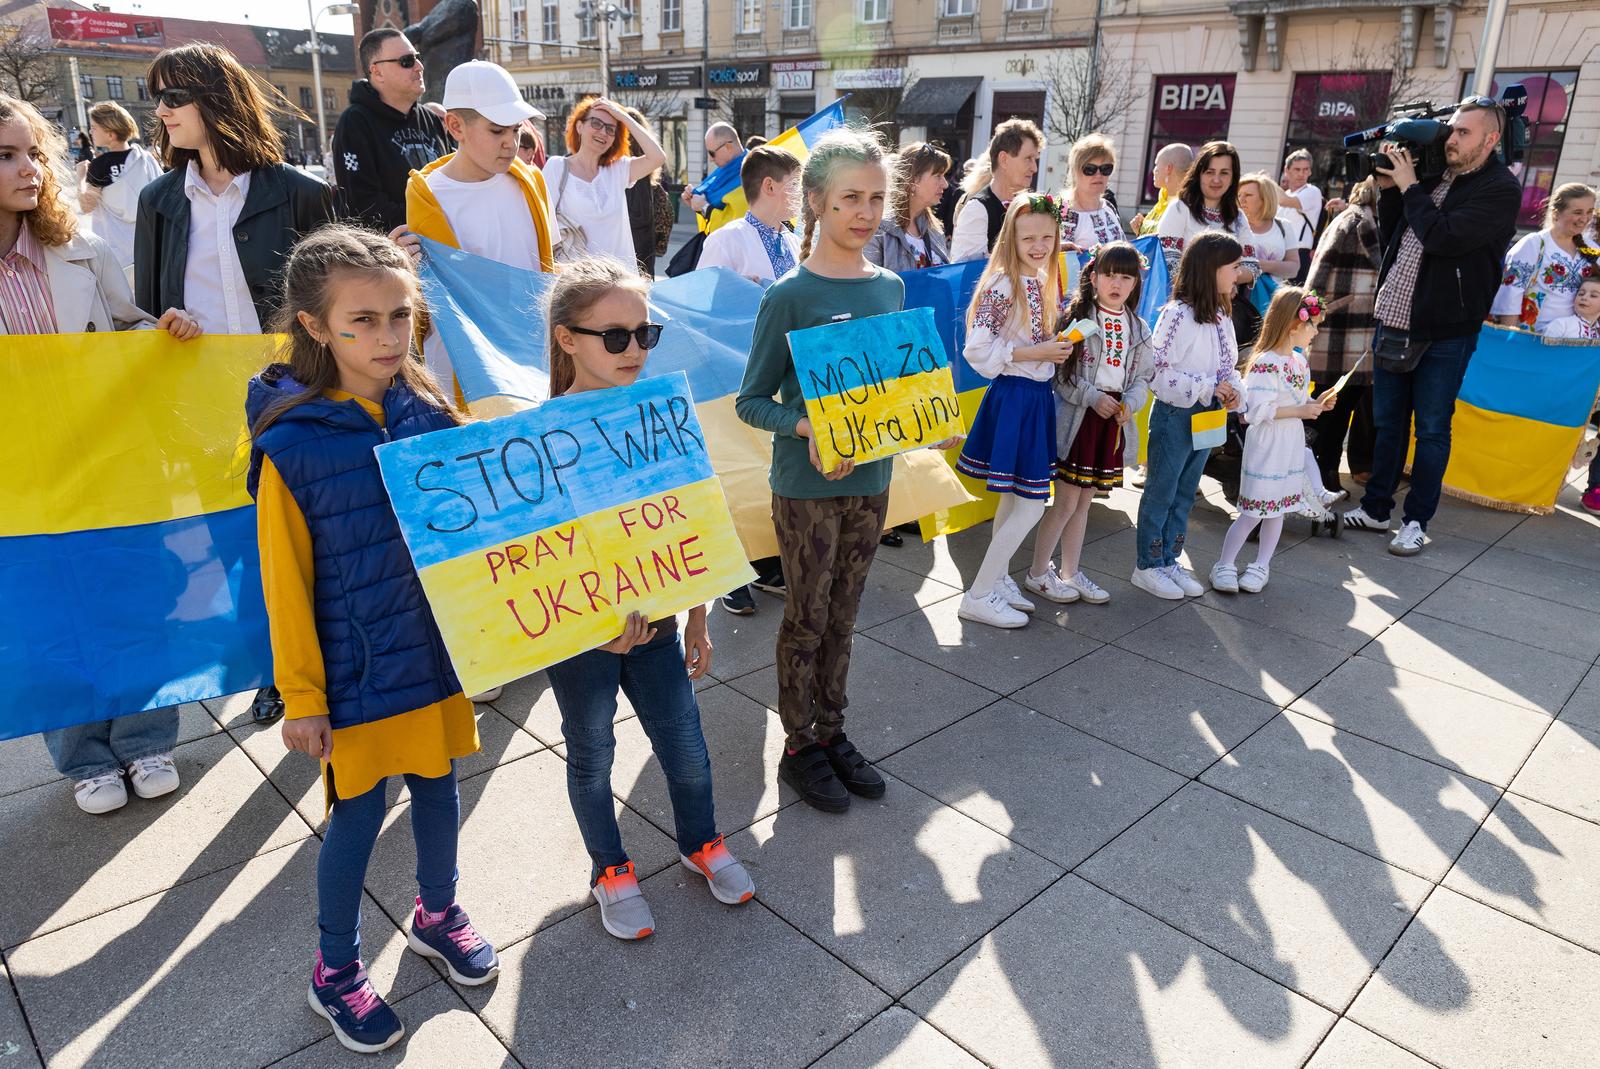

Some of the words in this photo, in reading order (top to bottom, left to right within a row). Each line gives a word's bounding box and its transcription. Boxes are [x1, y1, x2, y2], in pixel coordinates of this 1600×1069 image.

[1160, 83, 1226, 111] BIPA
[1318, 101, 1355, 116] BIPA
[414, 428, 583, 534] STOP
[590, 395, 707, 470] WAR
[485, 525, 576, 585] PRAY
[617, 494, 687, 538] FOR
[506, 534, 709, 640] UKRAINE
